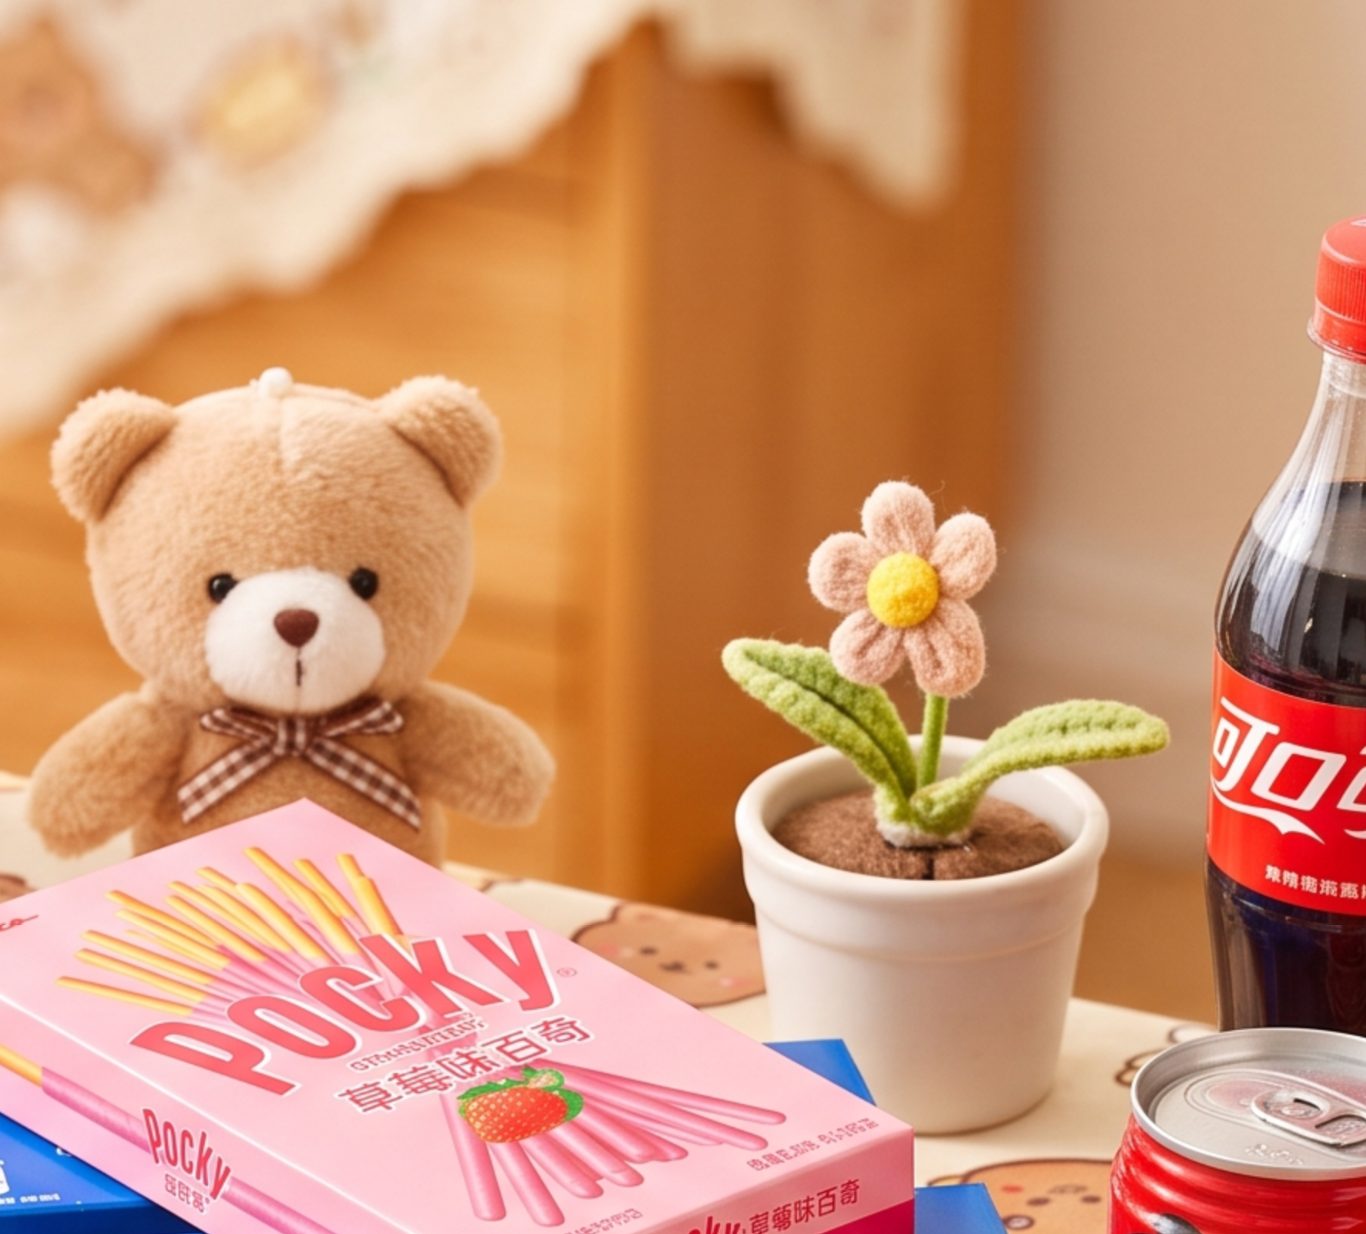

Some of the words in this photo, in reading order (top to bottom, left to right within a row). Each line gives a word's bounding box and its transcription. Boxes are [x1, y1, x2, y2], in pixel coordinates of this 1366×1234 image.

[338, 1016, 592, 1113] 草莓味百奇
